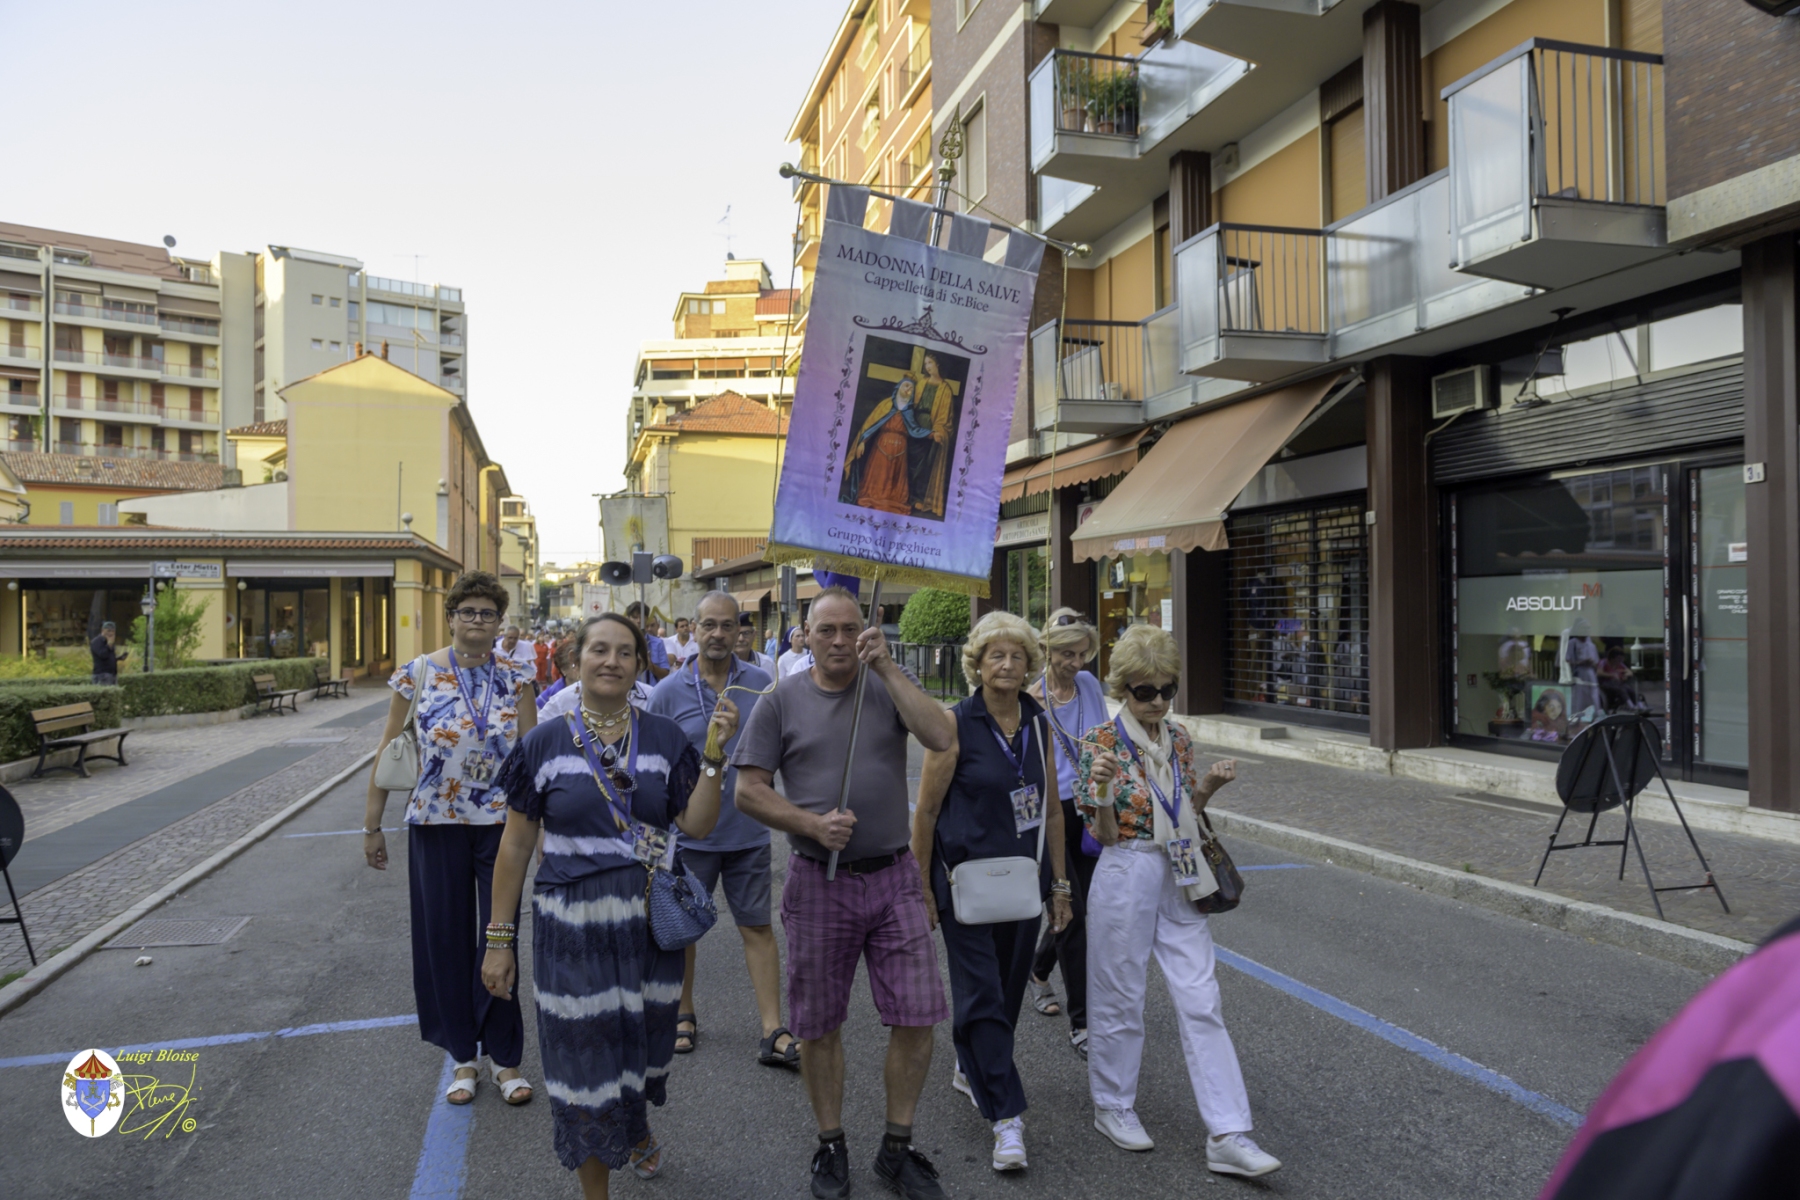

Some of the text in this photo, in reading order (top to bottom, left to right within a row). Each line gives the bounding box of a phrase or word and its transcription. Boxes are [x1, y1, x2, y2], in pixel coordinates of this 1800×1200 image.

[836, 244, 1021, 304] MADONNA DELLA SALVE
[864, 271, 989, 312] Cappelletta di Sr.Bice
[827, 527, 942, 557] Gruppo di preghiera
[840, 544, 898, 565] TORTONA
[1506, 582, 1601, 611] ABSOLUT M
